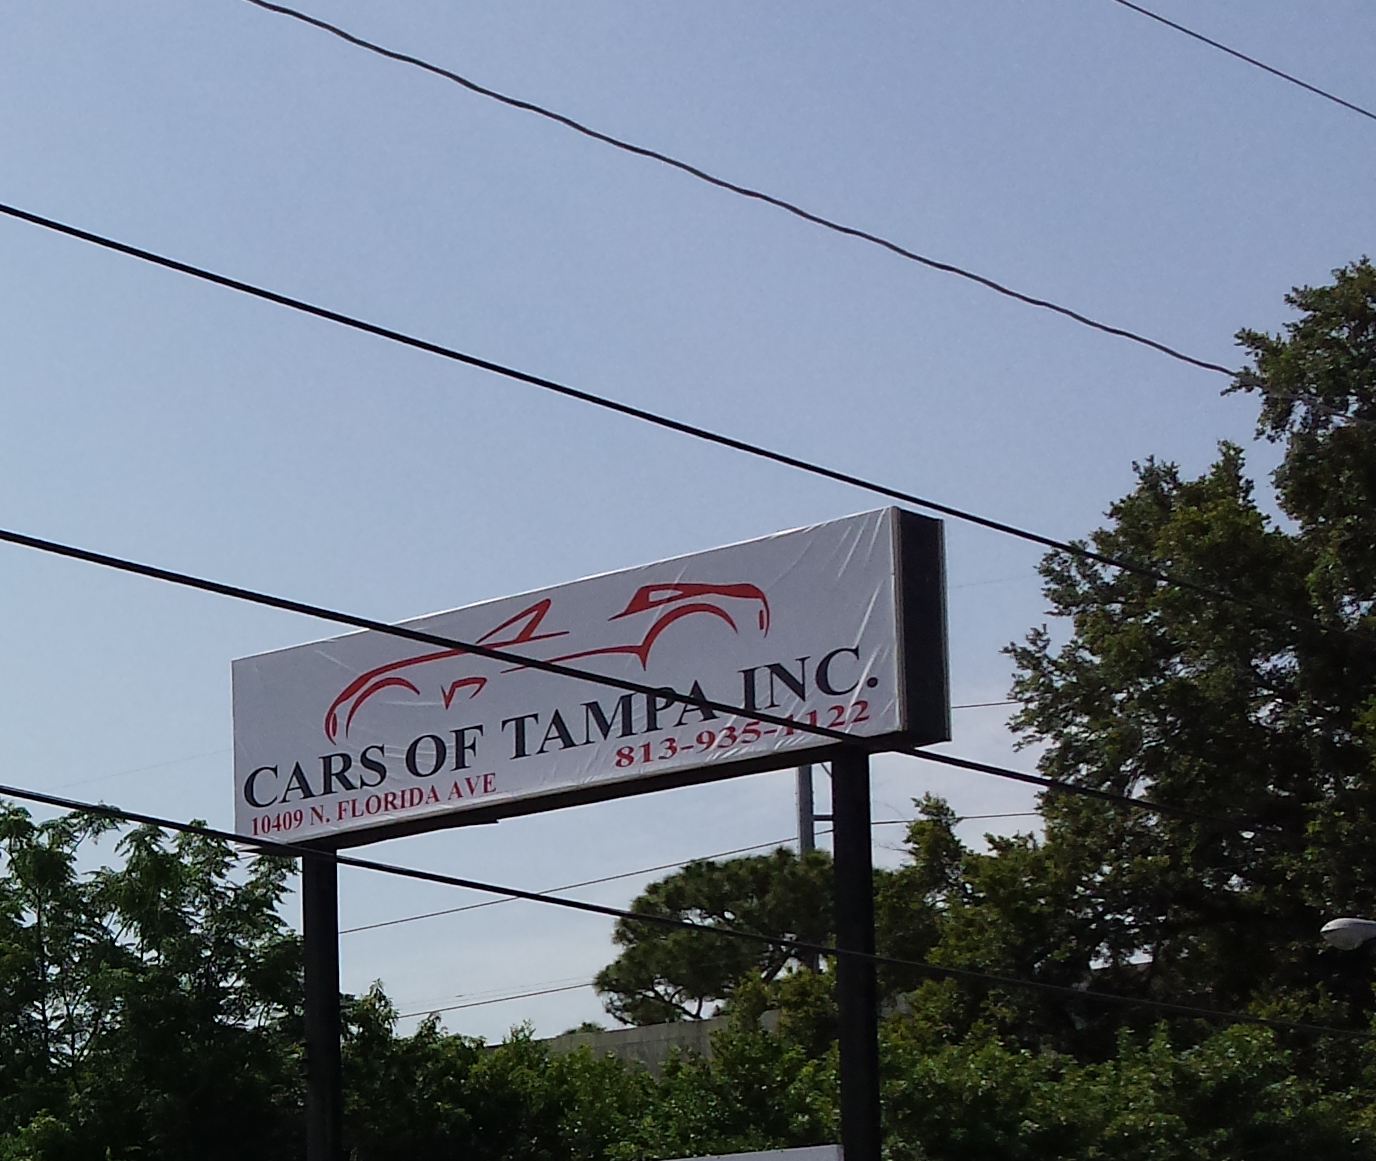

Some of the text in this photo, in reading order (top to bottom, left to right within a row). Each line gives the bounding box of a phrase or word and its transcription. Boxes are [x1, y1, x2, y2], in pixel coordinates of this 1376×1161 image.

[244, 646, 878, 808] CARS OF TAMPA INC.
[615, 700, 870, 768] 813-935-1122
[251, 772, 497, 836] 10409 N. FLORIDA AVE
